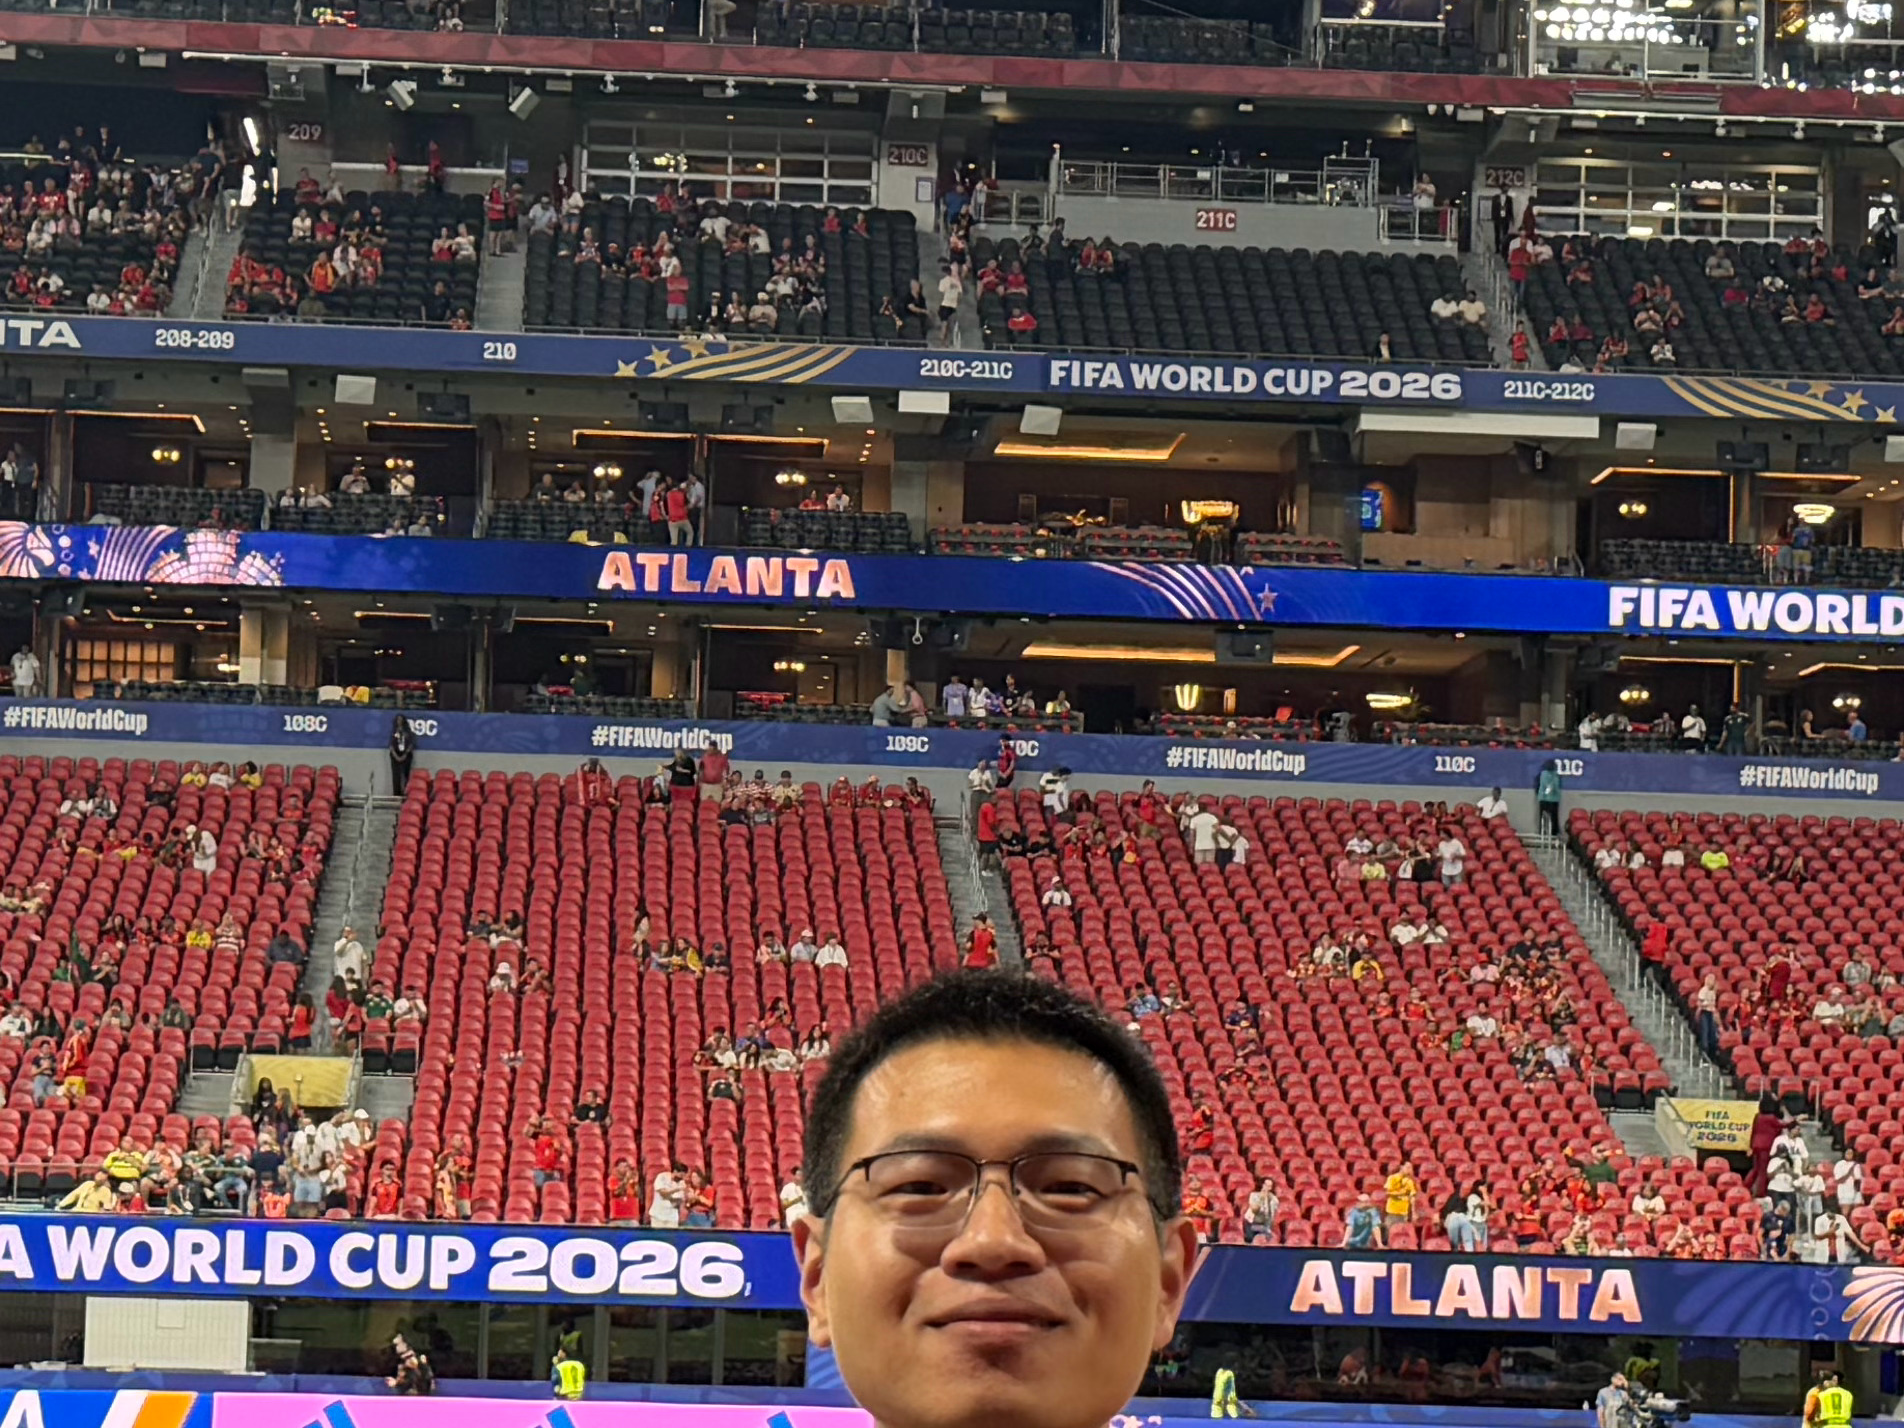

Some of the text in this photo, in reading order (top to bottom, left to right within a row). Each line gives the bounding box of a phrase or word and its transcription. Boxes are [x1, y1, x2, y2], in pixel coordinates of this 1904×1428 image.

[289, 124, 322, 140] 209
[889, 147, 928, 164] 210C
[1486, 170, 1524, 186] 212C
[1196, 211, 1236, 228] 211C
[156, 329, 234, 349] 208-209
[484, 342, 516, 359] 210
[921, 359, 1012, 379] 210C-211C
[1051, 360, 1461, 399] FIFA WORLD CUP 2026
[1505, 381, 1594, 400] 211C-212C
[598, 552, 855, 598] ATLANTA
[1610, 587, 1720, 629] FIFA
[4, 707, 147, 735] #FIFAWorldCup
[284, 715, 327, 731] 108C
[592, 726, 732, 756] #FIFAWorldCup
[886, 736, 928, 752] 109C
[1167, 747, 1305, 775] #FIFAWorldCup
[1436, 756, 1475, 772] 110C
[1555, 759, 1583, 775] 11C
[1740, 766, 1878, 794] #FIFAWorldCup
[1729, 1122, 1750, 1131] CUP
[47, 1226, 315, 1285] WORLD
[330, 1232, 476, 1289] CUP
[489, 1237, 744, 1297] 2026
[1290, 1260, 1642, 1322] ATLANTA
